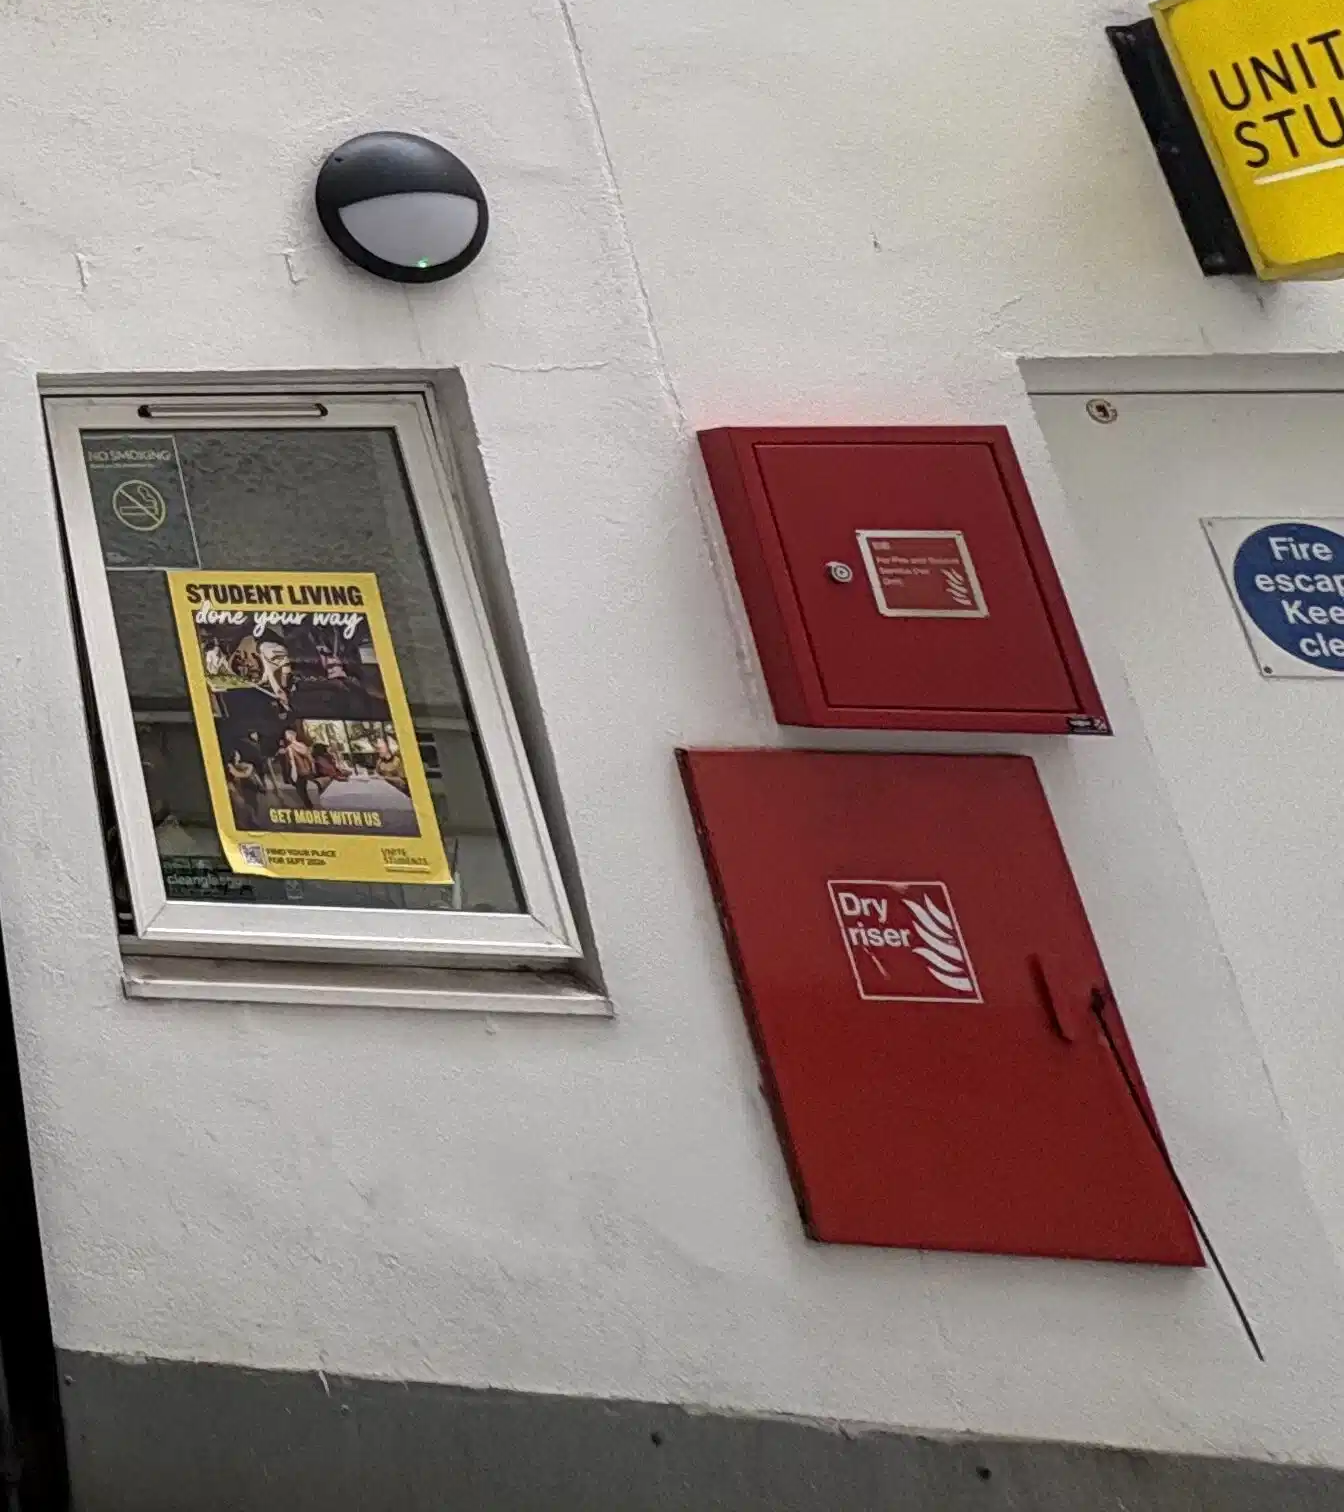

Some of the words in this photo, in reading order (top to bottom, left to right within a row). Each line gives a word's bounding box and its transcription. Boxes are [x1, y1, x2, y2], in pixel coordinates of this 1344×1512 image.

[1268, 536, 1334, 562] Fire
[186, 584, 285, 605] STUDENT
[285, 585, 365, 606] LIVING
[195, 600, 249, 626] done
[252, 610, 308, 638] your
[312, 611, 365, 639] way
[1281, 599, 1344, 626] Kee
[1299, 631, 1344, 658] cle
[270, 808, 292, 824] GET
[293, 809, 330, 826] MORE
[330, 810, 363, 827] WITH
[363, 811, 382, 827] US
[310, 849, 337, 858] PLACE
[838, 892, 888, 923] Dry
[848, 921, 911, 947] riser
